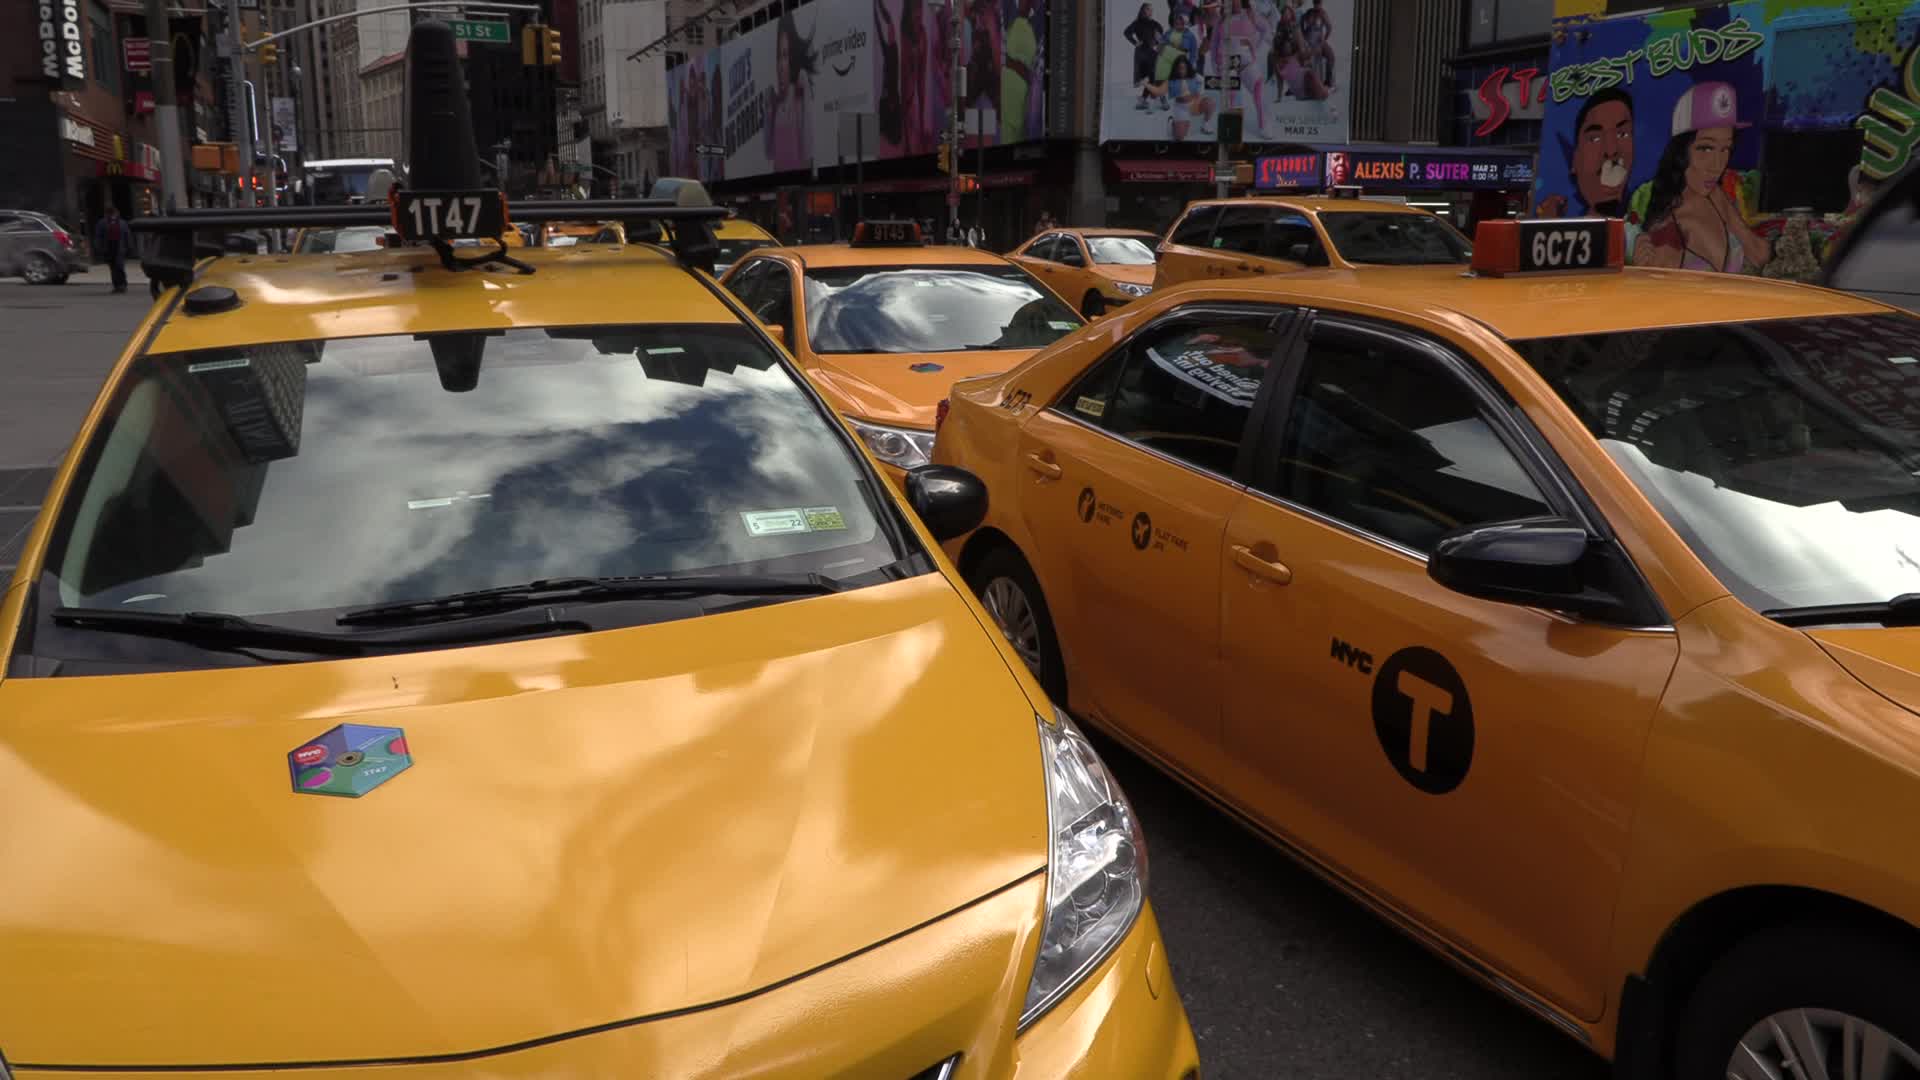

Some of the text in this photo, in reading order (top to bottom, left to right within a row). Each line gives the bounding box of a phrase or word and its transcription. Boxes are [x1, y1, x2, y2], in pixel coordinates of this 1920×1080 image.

[455, 25, 492, 37] 51 St
[844, 25, 867, 52] video
[1551, 18, 1765, 103] BEST BUDS
[1284, 126, 1320, 136] MAR 25
[1354, 160, 1470, 181] ALEXIS P. SUTER
[1472, 164, 1488, 173] MAR
[1489, 164, 1498, 173] 21
[408, 197, 482, 236] 1T47
[1532, 230, 1592, 266] 6C73
[790, 519, 802, 527] 22
[1330, 636, 1454, 774] NYC T
